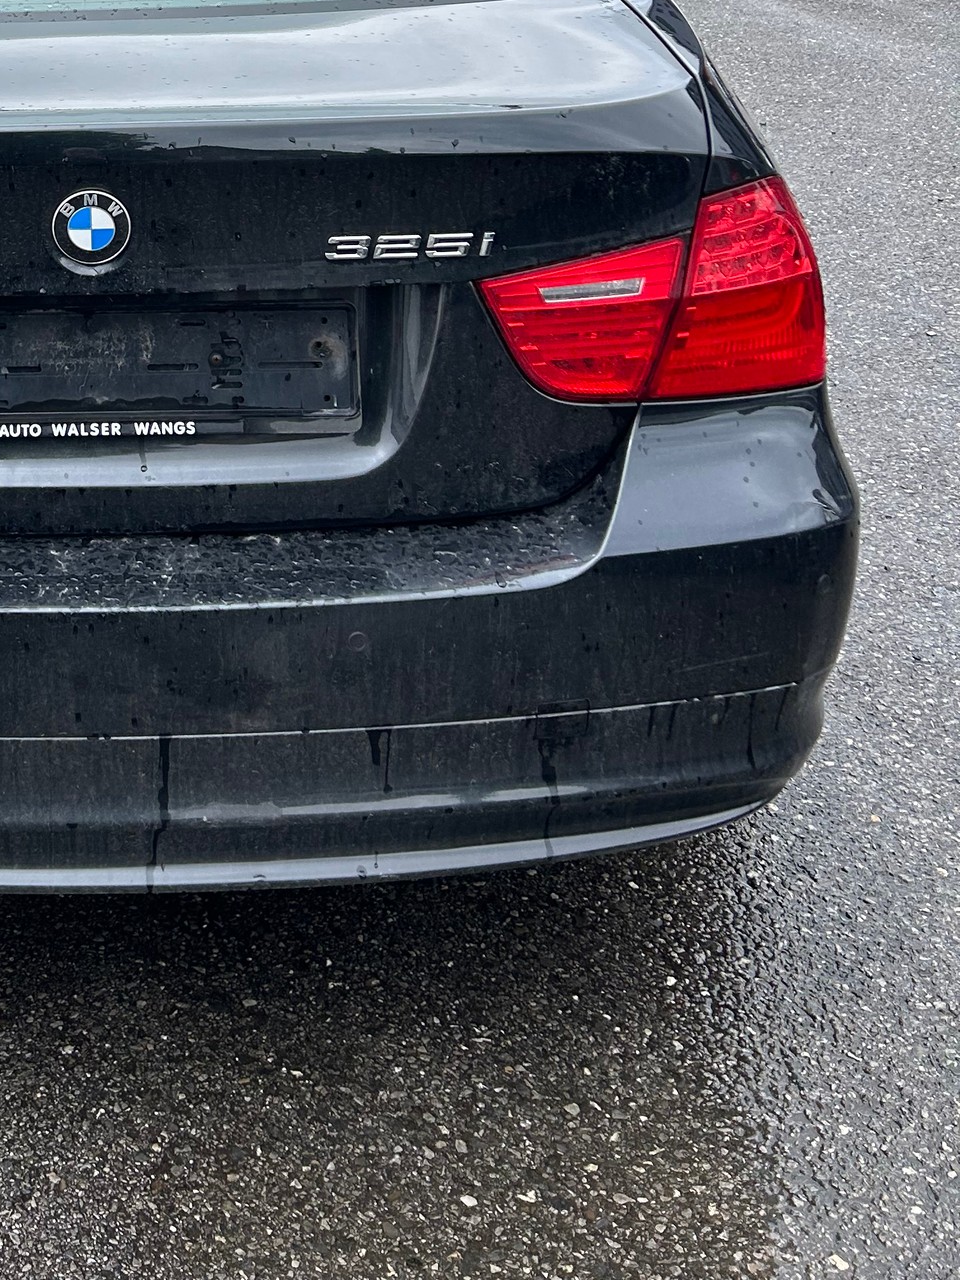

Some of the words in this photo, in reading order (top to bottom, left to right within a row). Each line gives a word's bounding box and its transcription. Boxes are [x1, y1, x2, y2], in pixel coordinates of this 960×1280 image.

[59, 193, 123, 218] BMW
[324, 231, 496, 260] 325i
[51, 422, 122, 437] WALSER
[133, 421, 196, 436] WANGS
